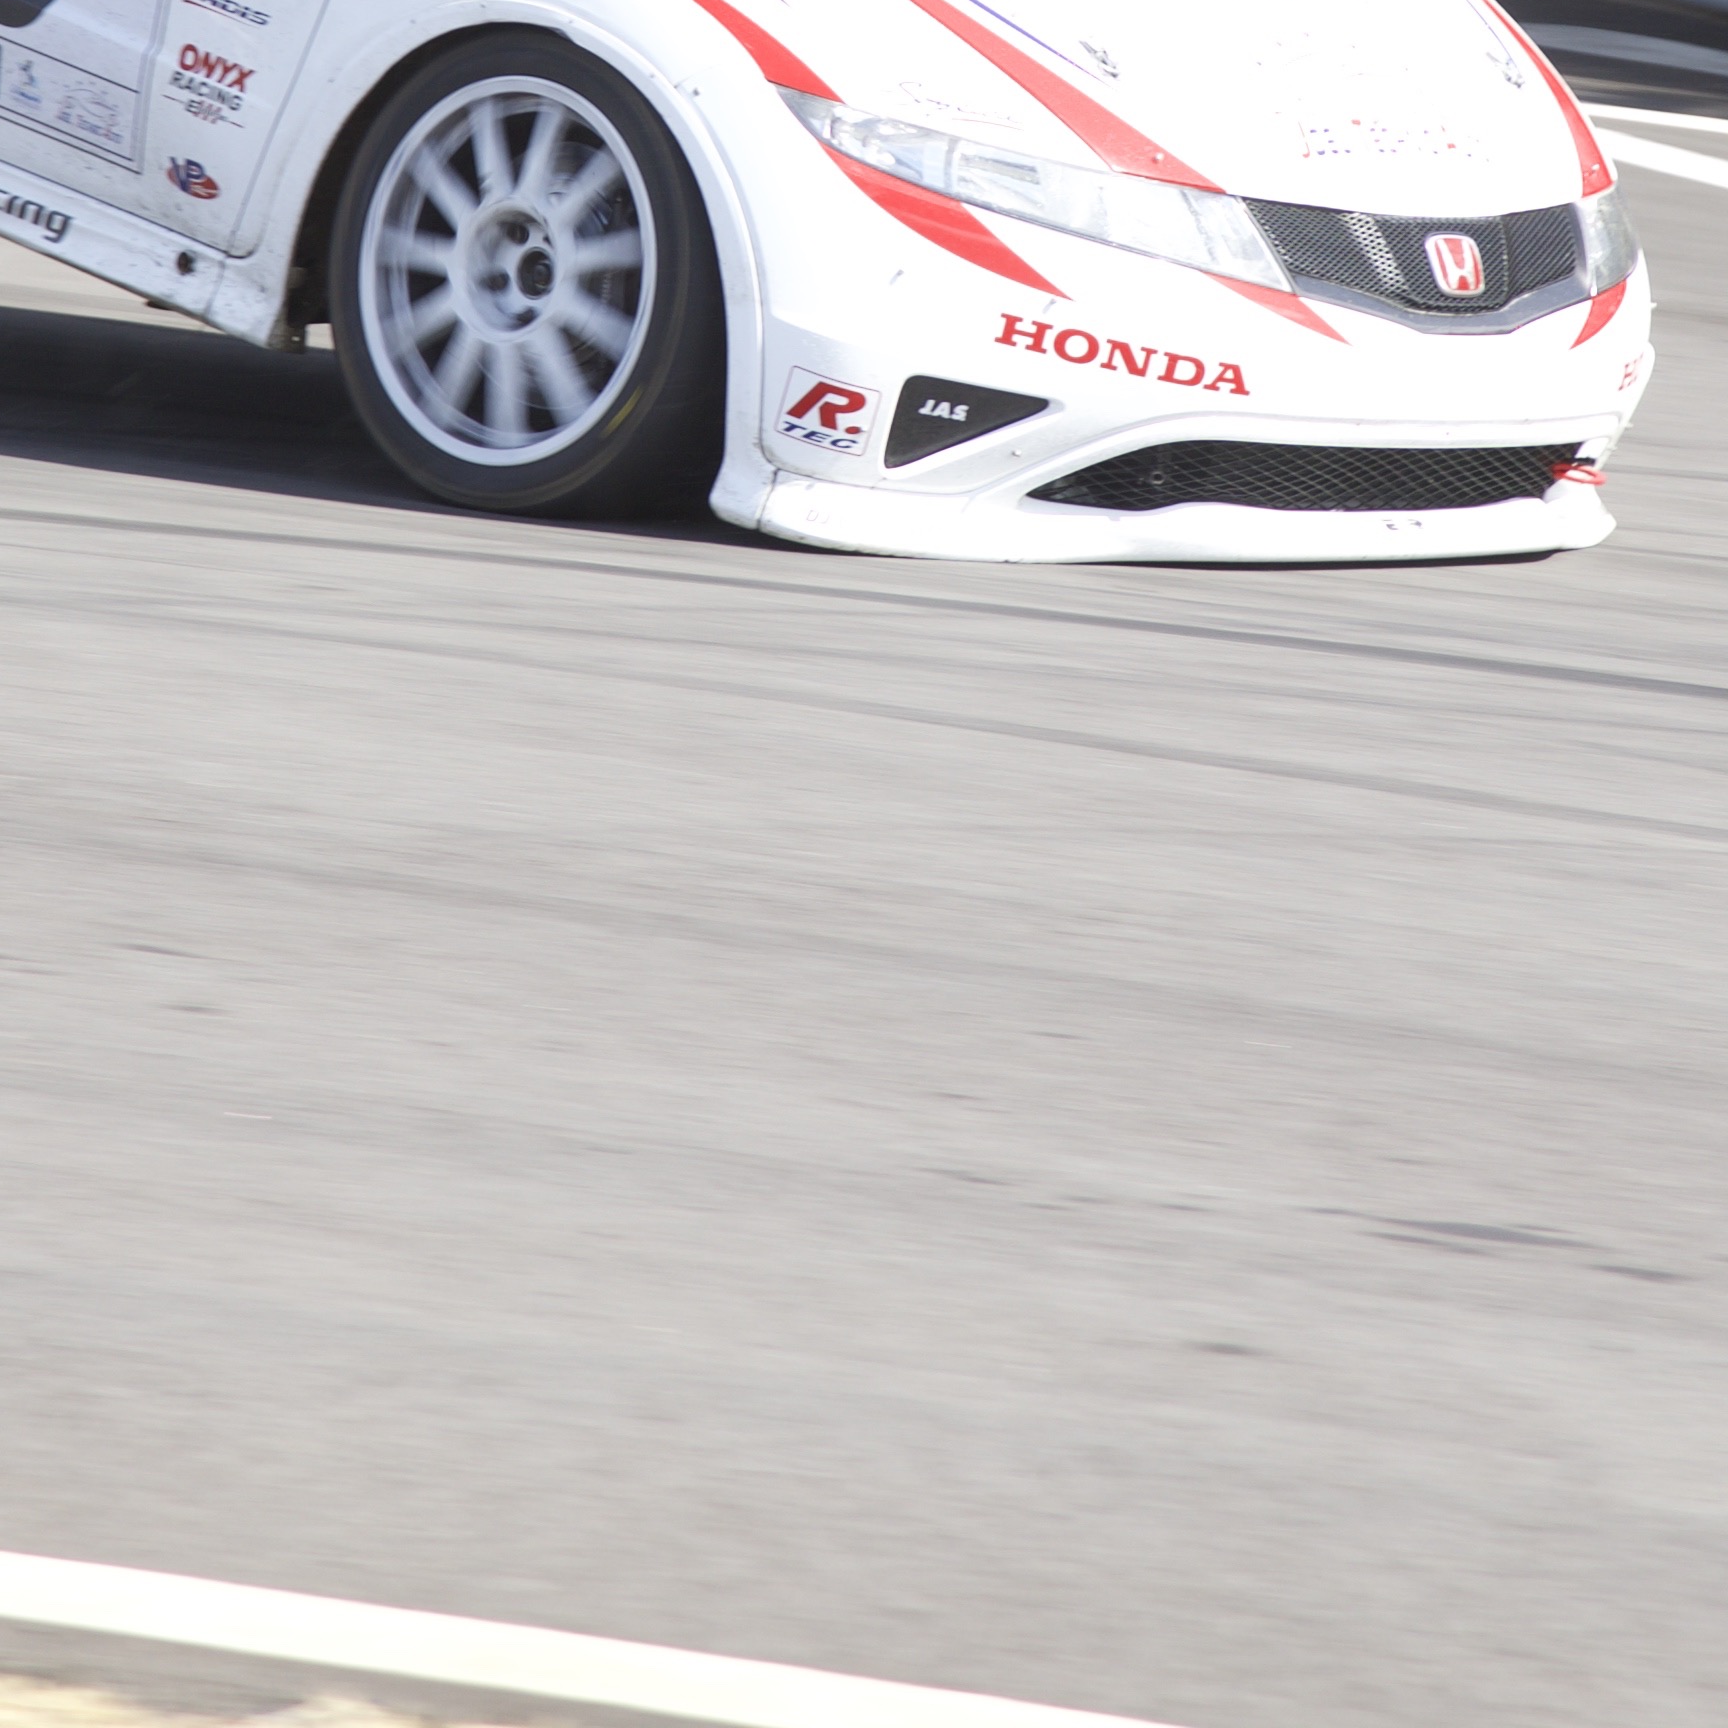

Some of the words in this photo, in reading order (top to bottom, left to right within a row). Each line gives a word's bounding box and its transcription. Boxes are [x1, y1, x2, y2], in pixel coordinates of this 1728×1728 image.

[179, 43, 256, 93] ONYX
[168, 71, 244, 111] RACING
[994, 313, 1251, 396] HONDA
[918, 399, 970, 422] JAS
[782, 420, 859, 449] TEC
